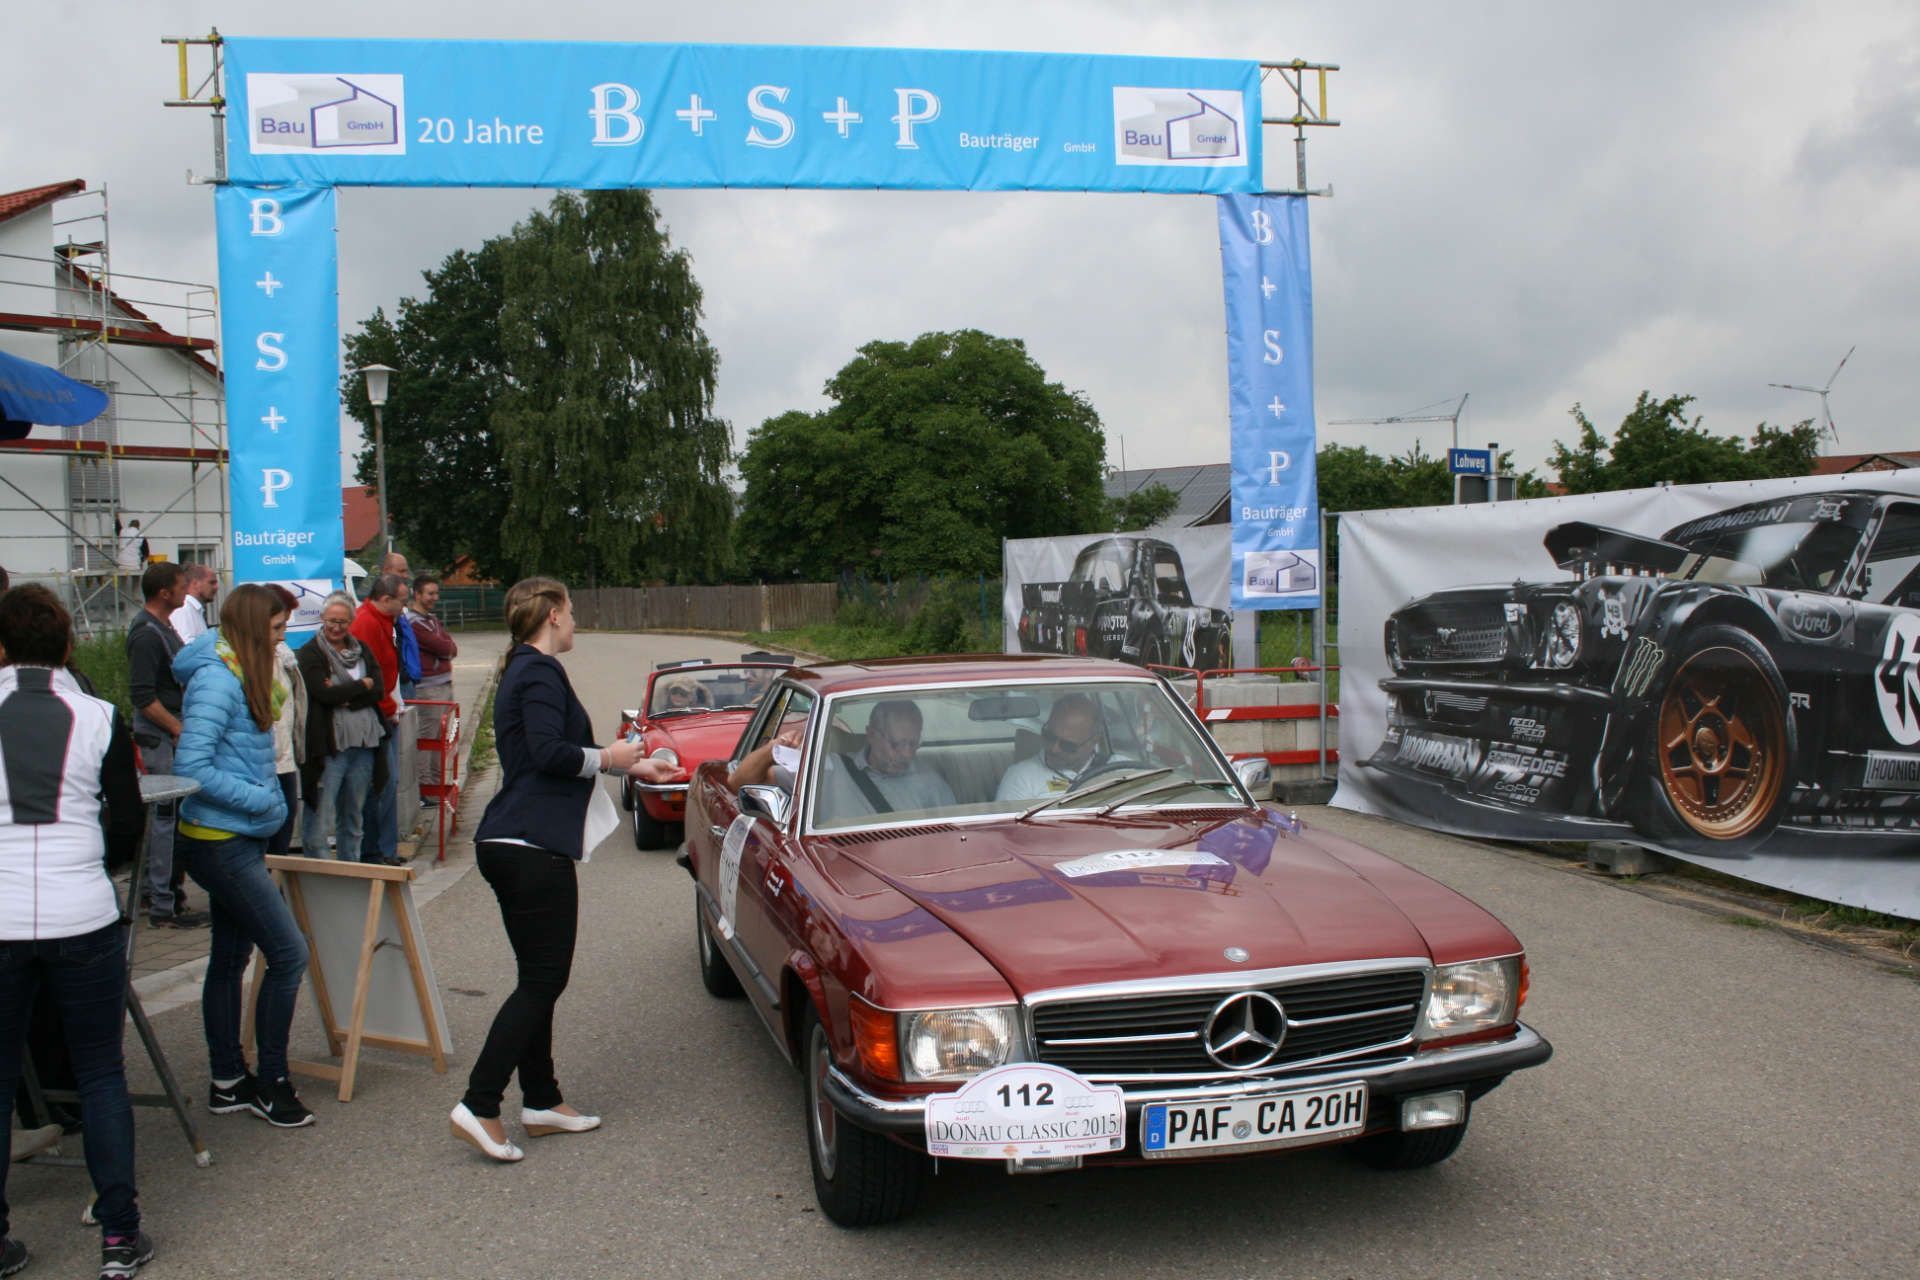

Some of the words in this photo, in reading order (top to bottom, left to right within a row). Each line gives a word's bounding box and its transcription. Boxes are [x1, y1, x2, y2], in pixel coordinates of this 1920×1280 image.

[260, 117, 305, 134] Bau
[347, 120, 384, 131] GmbH
[588, 82, 645, 147] B
[745, 84, 796, 149] S
[891, 87, 940, 150] P
[417, 118, 455, 144] 20
[463, 118, 544, 145] Jahre
[959, 131, 1040, 153] Bauträger
[1063, 141, 1096, 153] GmbH
[1124, 129, 1163, 146] Bau
[1196, 133, 1228, 145] GmbH
[249, 198, 285, 237] B
[1252, 209, 1275, 246] B
[256, 332, 288, 372] S
[1263, 329, 1284, 366] S
[1267, 450, 1290, 487] P
[1455, 453, 1485, 472] Lohweg
[260, 468, 293, 508] P
[1242, 505, 1308, 521] Bauträger
[235, 529, 315, 549] Bauträger
[1267, 527, 1294, 537] GmbH
[262, 554, 296, 566] GmbH
[1248, 576, 1273, 586] Bau
[1793, 610, 1833, 634] Ford
[1519, 754, 1568, 778] EDGE
[1495, 781, 1540, 797] GoPro
[997, 1083, 1054, 1107] 112
[1168, 1105, 1232, 1144] PAF
[1257, 1099, 1296, 1135] CA
[1304, 1089, 1363, 1130] 20H
[936, 1120, 1001, 1141] DONAU
[1007, 1119, 1078, 1140] CLASSIC
